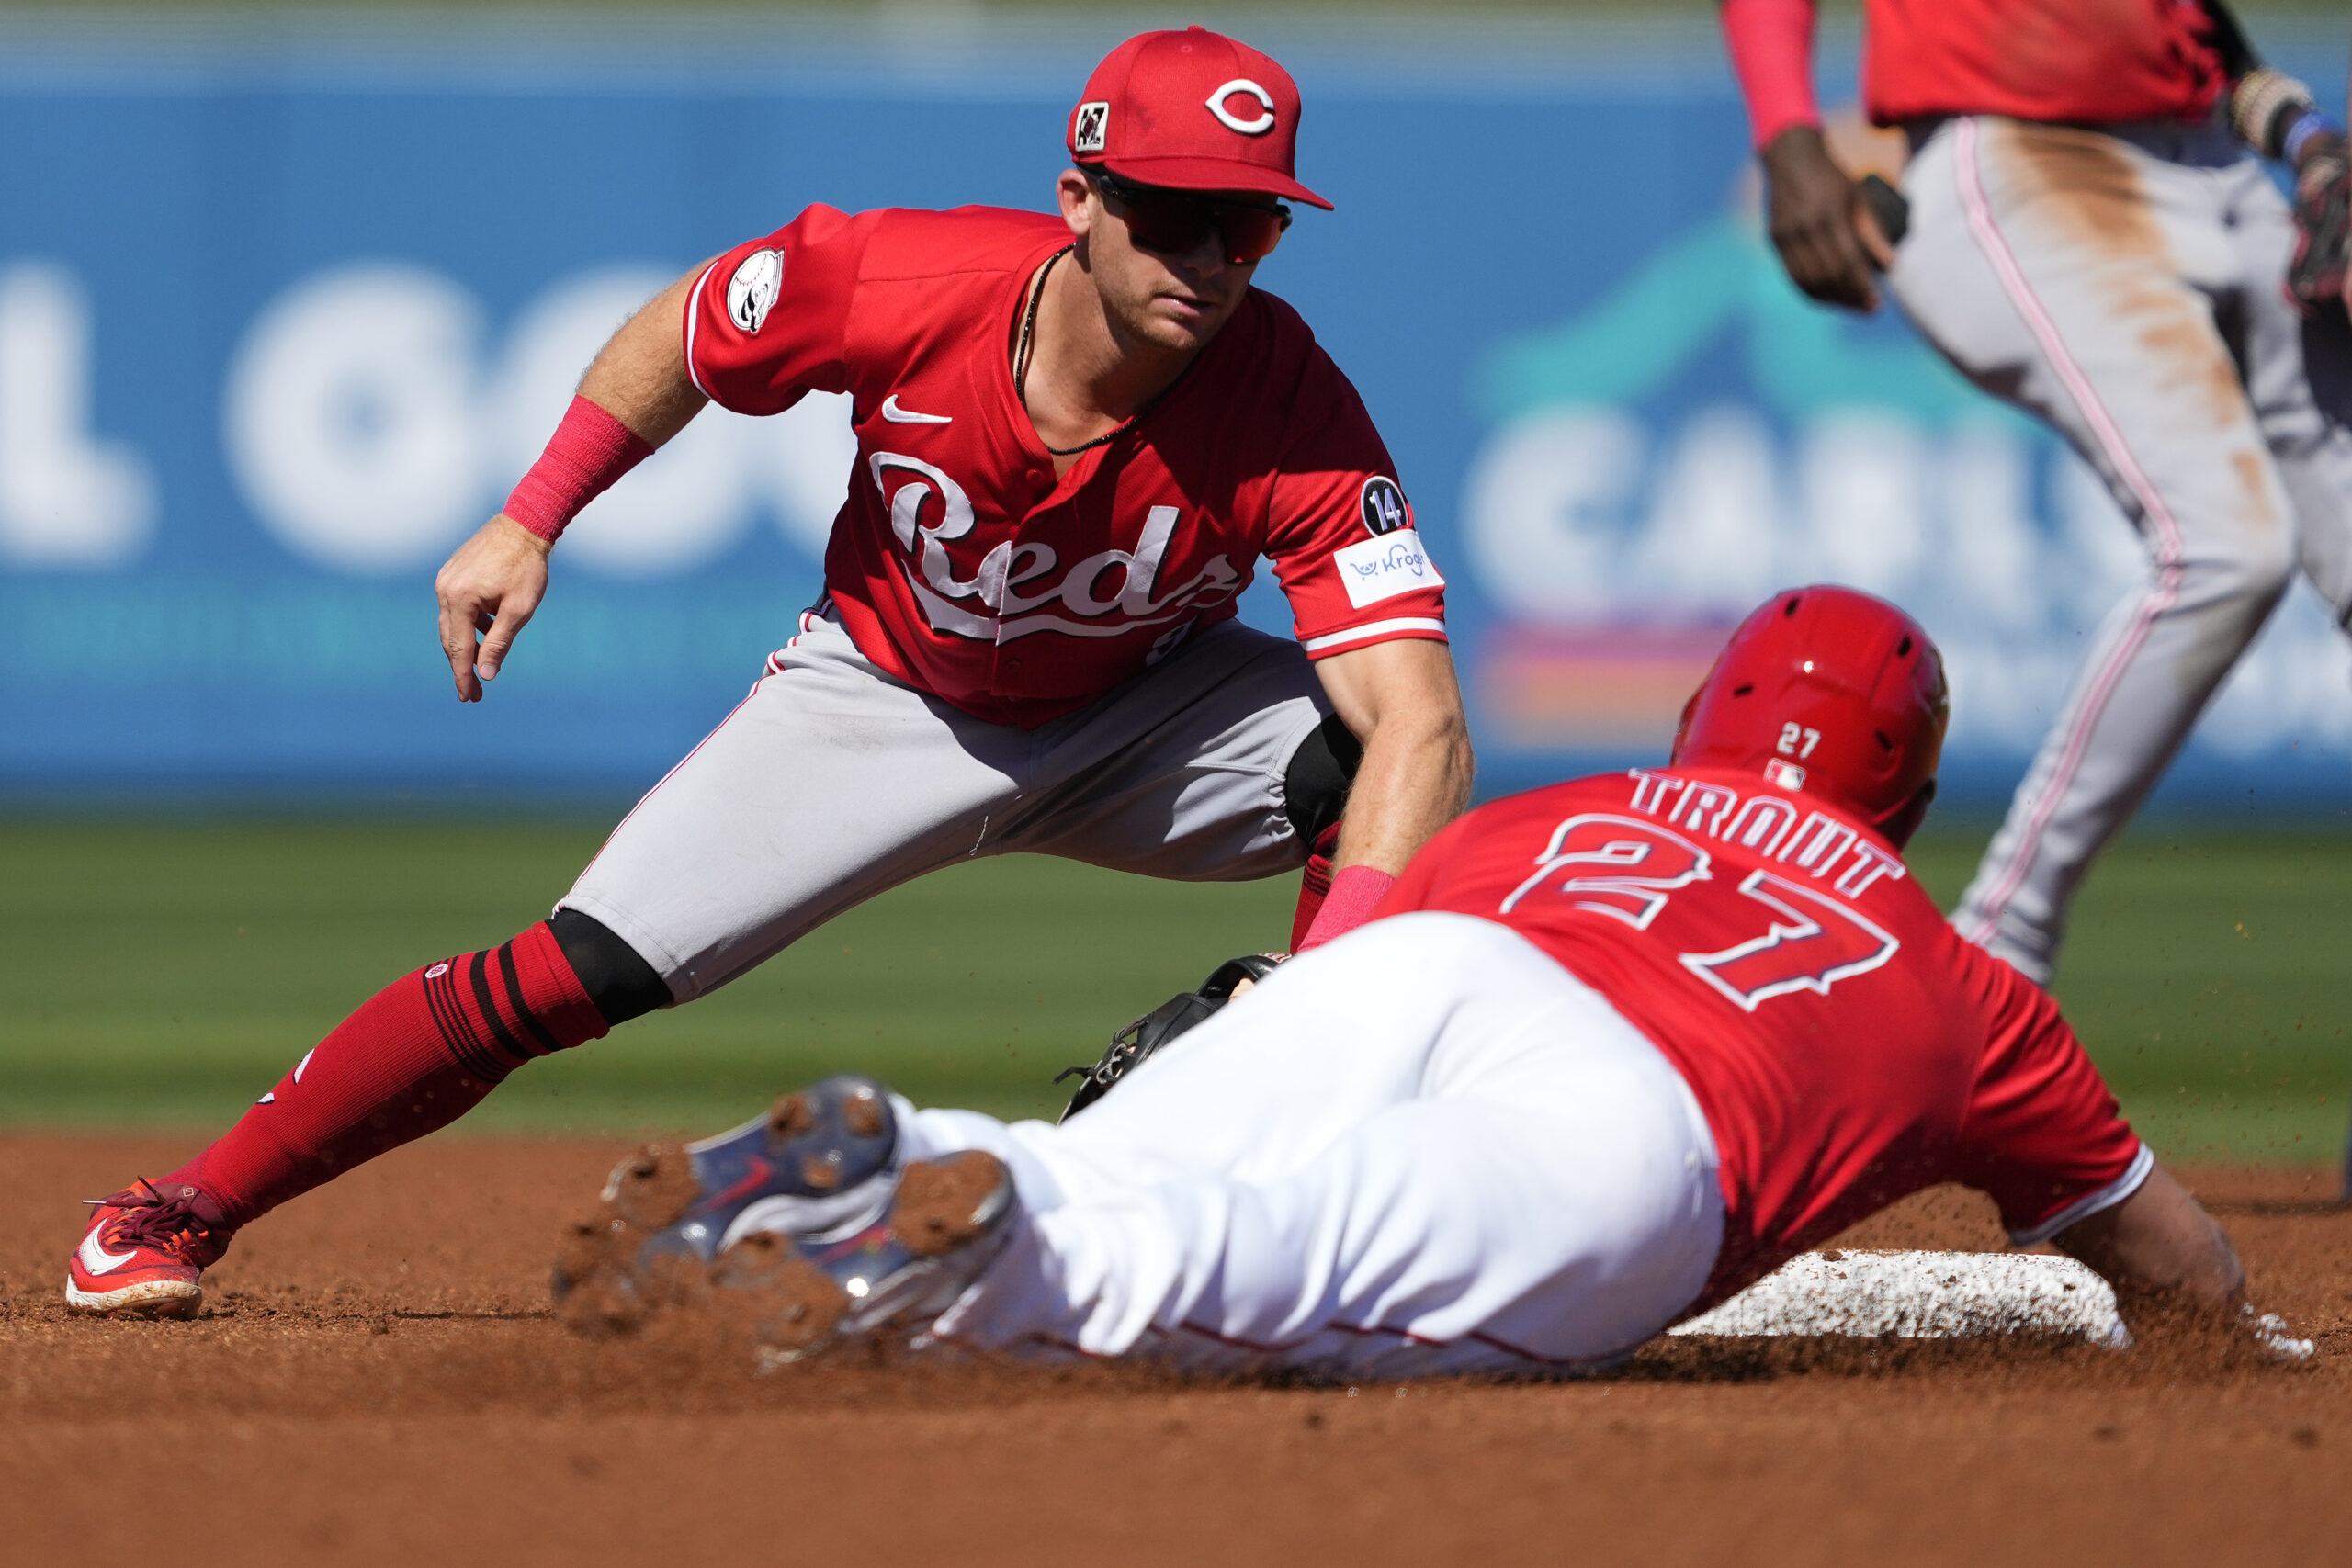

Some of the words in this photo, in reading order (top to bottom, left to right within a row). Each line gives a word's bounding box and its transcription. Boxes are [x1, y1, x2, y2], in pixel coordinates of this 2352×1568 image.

[1204, 79, 1274, 133] C
[869, 451, 1240, 617] Reds
[1369, 487, 1402, 531] 14
[1776, 721, 1821, 760] 27
[1629, 768, 1906, 899] TROUT
[1499, 813, 1901, 1011] 27
